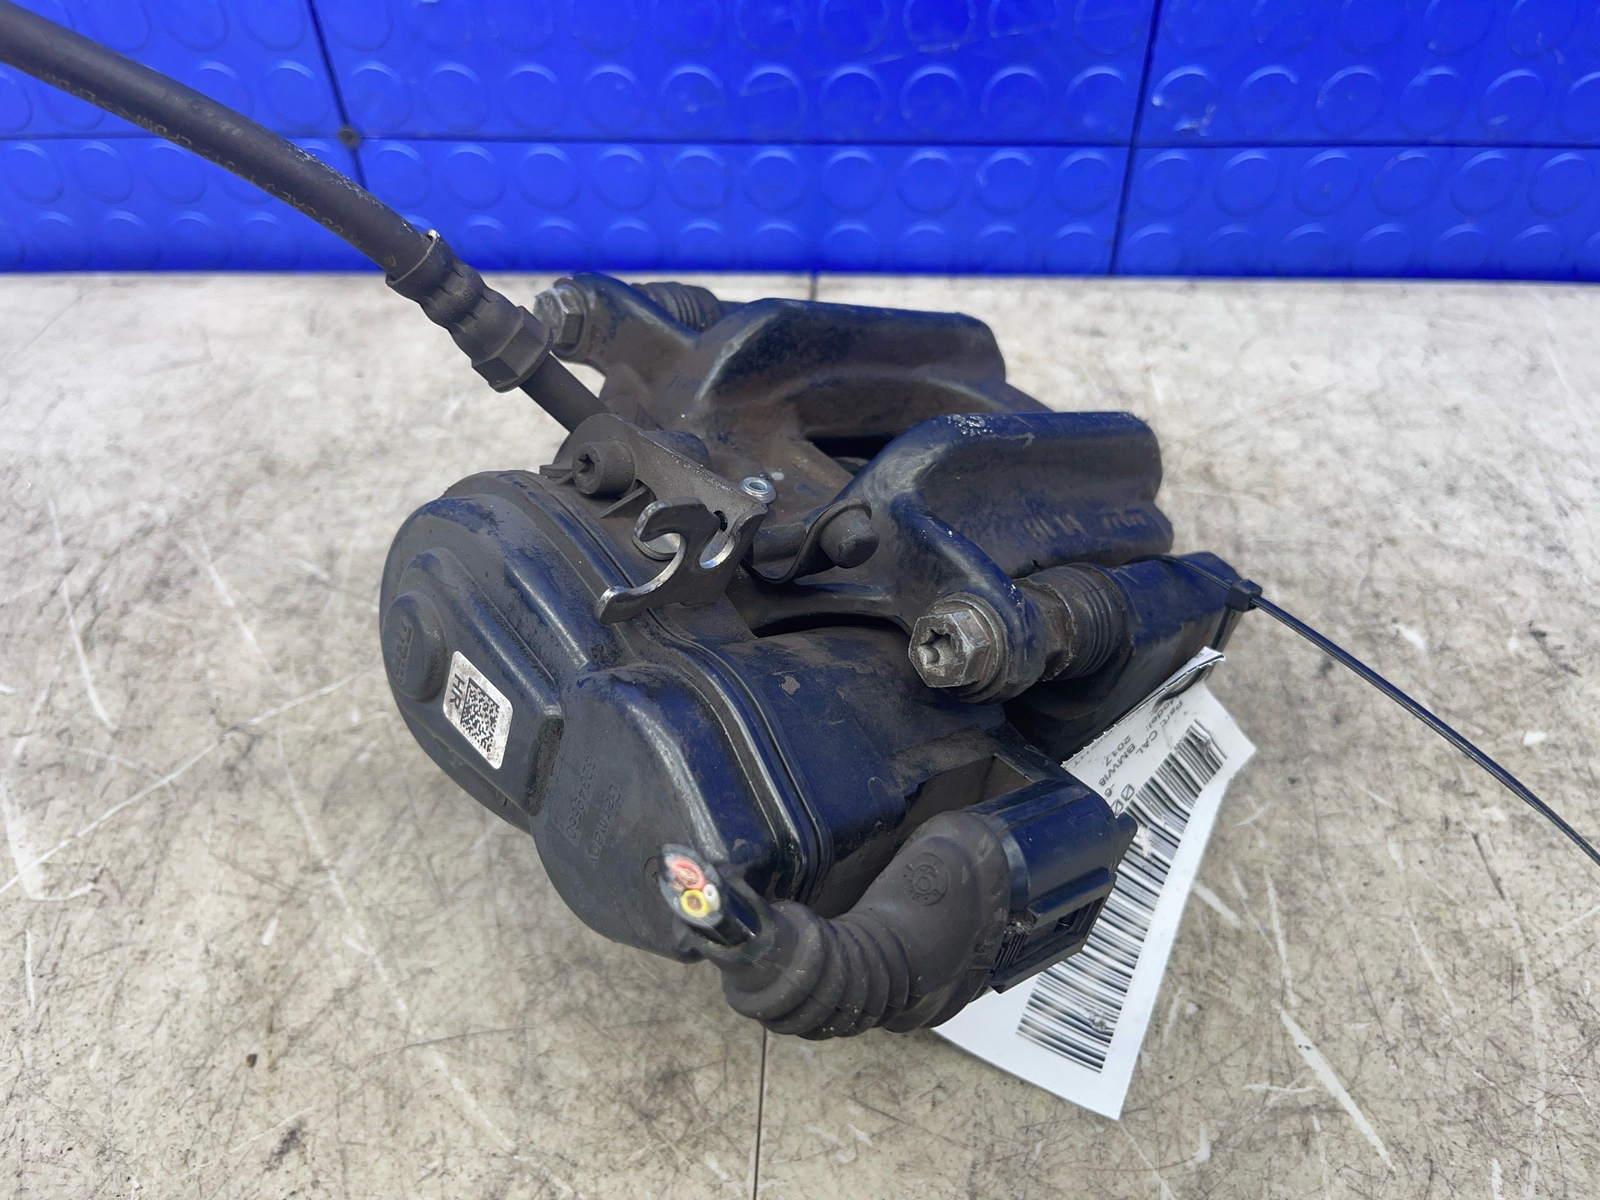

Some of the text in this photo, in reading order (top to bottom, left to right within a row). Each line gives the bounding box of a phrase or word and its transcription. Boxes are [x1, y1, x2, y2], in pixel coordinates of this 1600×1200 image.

[449, 673, 465, 709] HR
[1159, 699, 1183, 727] Part:
[1104, 735, 1131, 766] 2017
[1134, 729, 1158, 754] CAL
[586, 784, 621, 868] Germany
